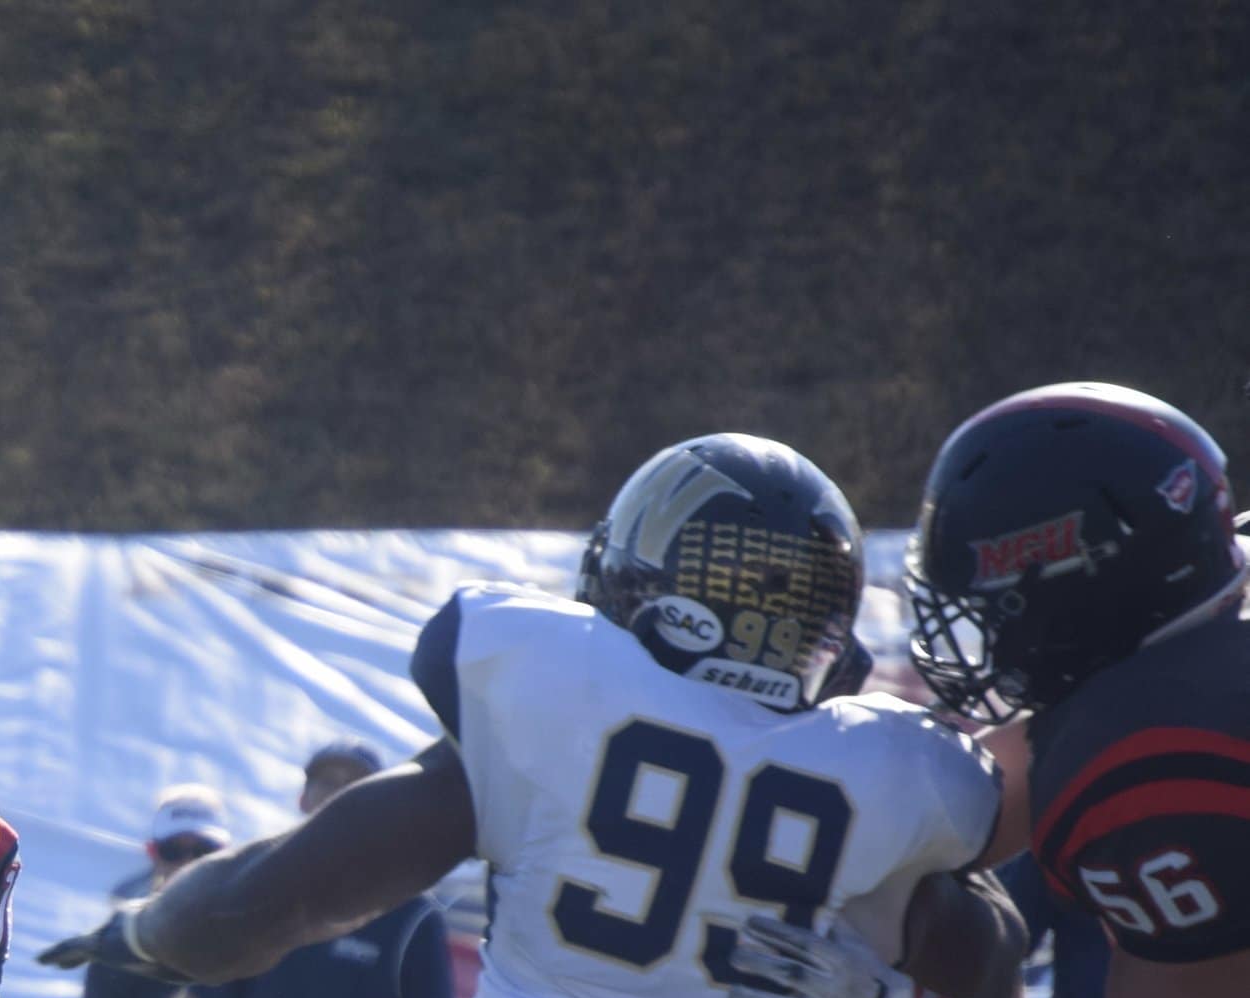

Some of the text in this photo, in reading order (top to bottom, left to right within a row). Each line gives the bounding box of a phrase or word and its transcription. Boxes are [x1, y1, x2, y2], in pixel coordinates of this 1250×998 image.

[972, 513, 1083, 580] NGU
[661, 604, 716, 642] SAC
[724, 609, 801, 671] 99
[701, 658, 792, 698] schutt
[547, 713, 856, 998] 99
[1077, 850, 1219, 935] 56
